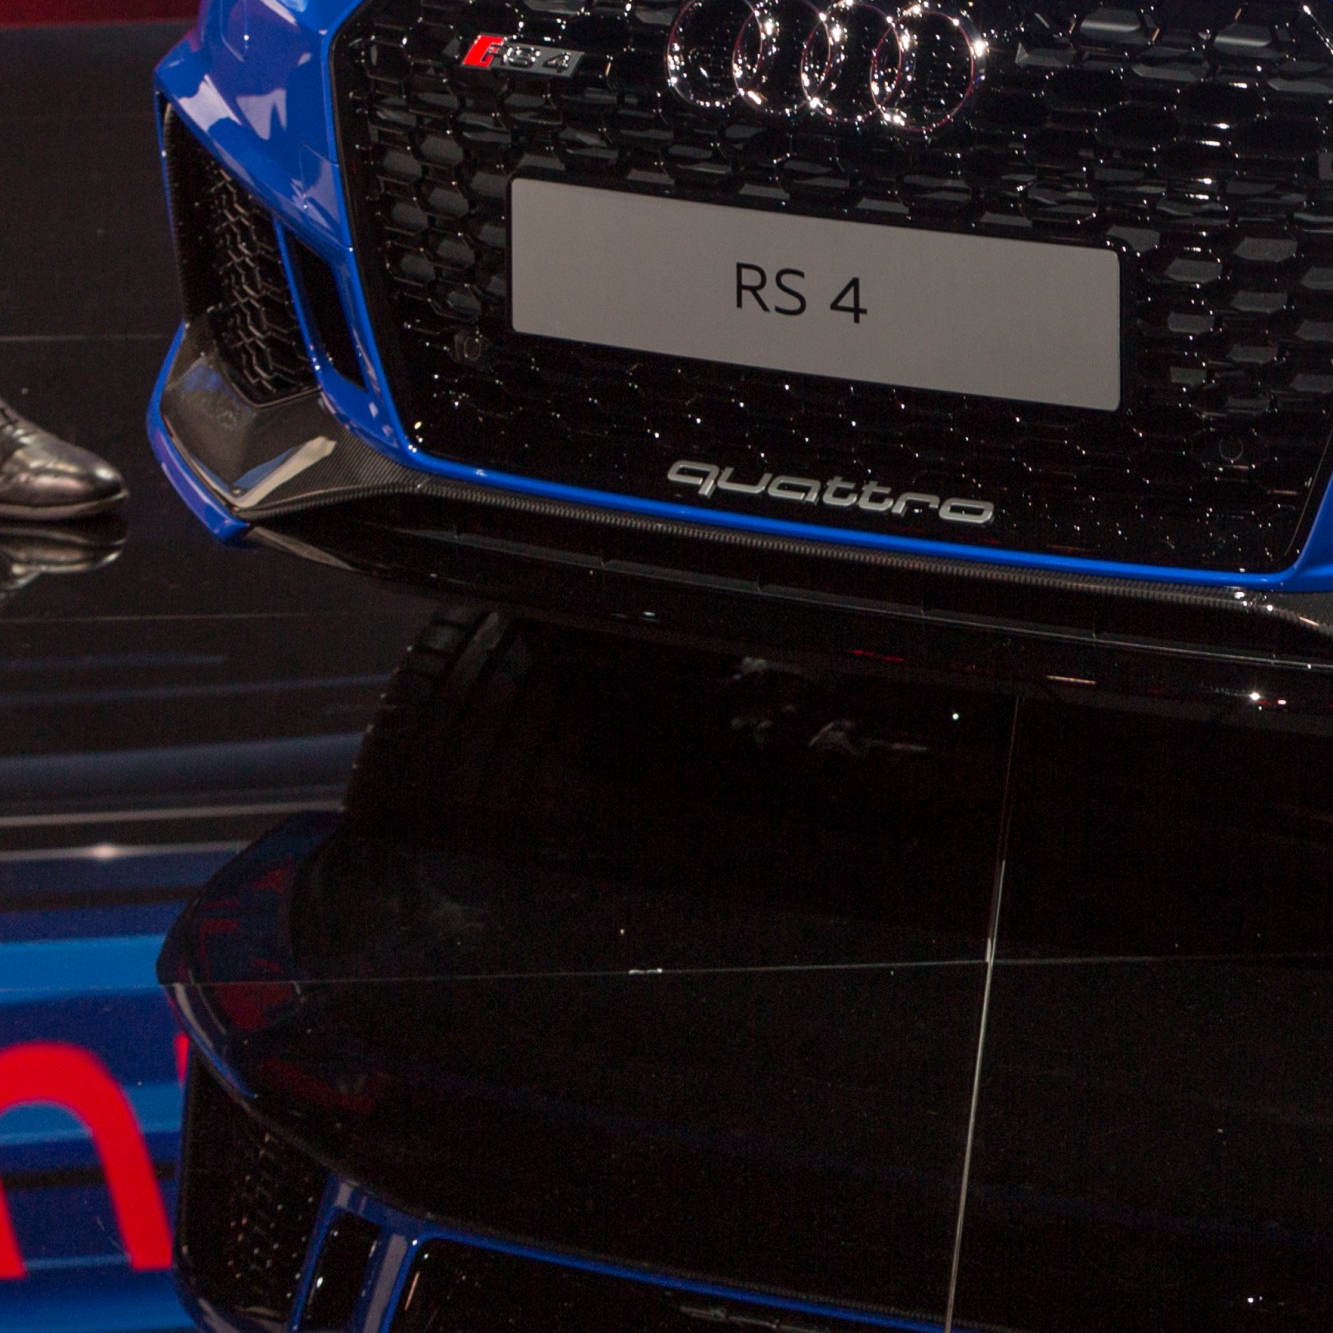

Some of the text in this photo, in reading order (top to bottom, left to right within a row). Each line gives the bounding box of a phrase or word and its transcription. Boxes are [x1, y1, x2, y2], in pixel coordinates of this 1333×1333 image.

[735, 261, 869, 325] RS 4
[666, 458, 997, 525] quattro
